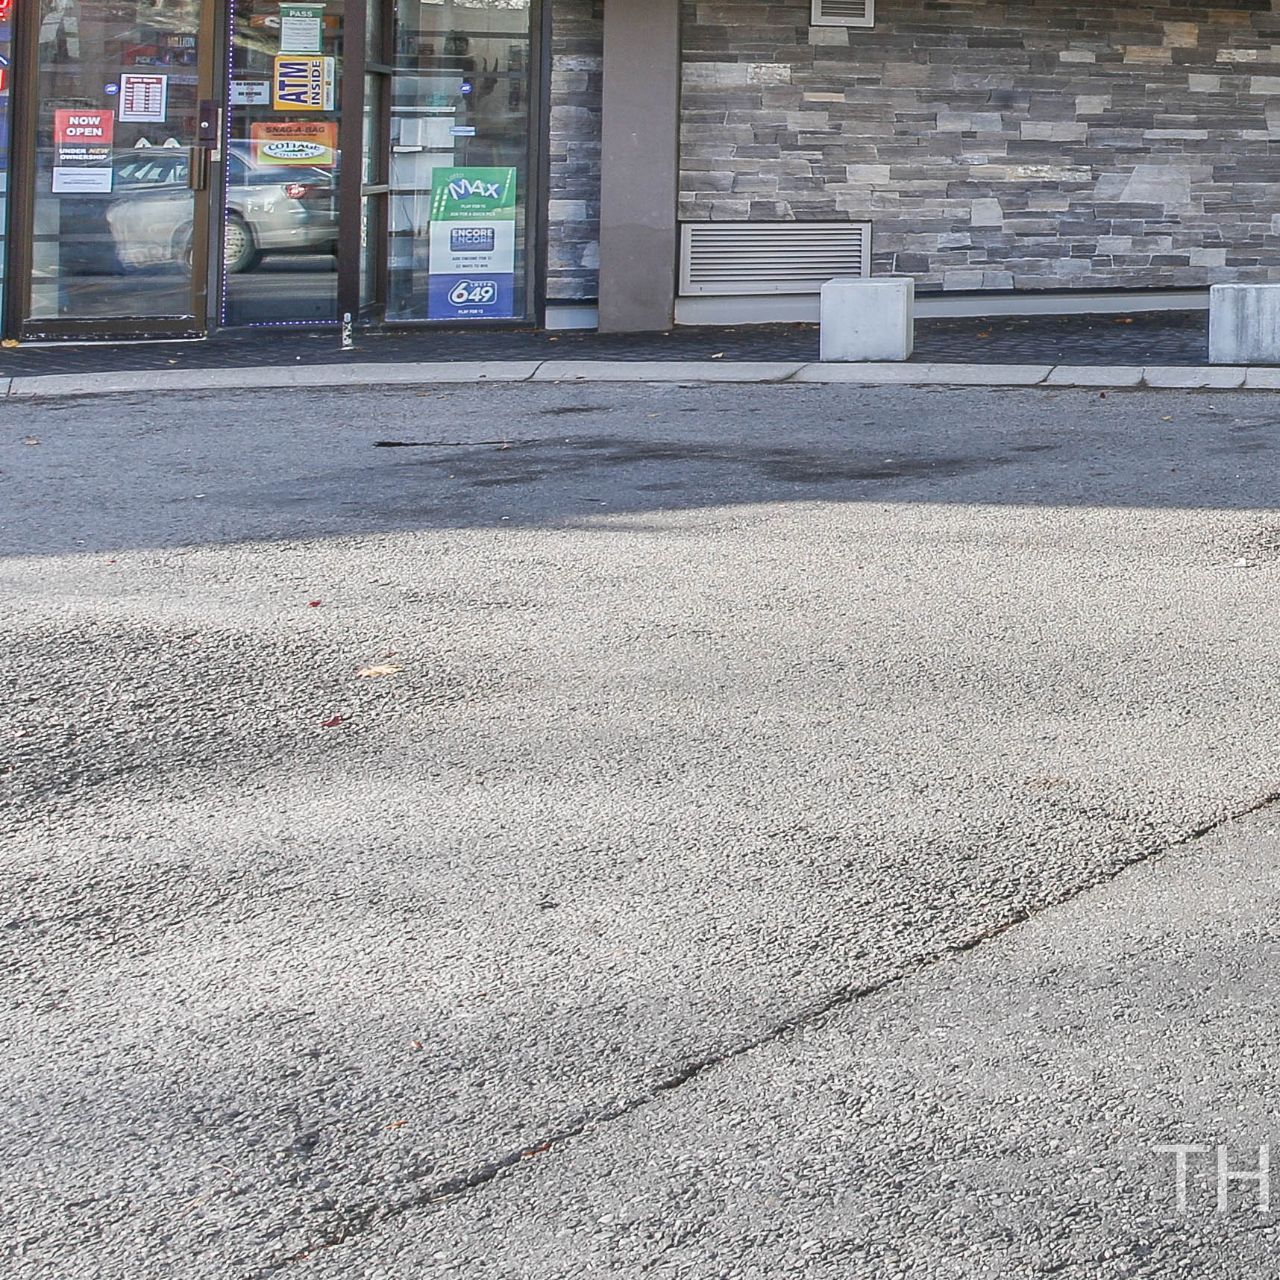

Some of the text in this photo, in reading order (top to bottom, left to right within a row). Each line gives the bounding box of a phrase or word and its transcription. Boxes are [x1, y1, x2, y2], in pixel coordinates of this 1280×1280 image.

[278, 62, 309, 104] ATM
[311, 61, 321, 105] INSIDE
[69, 117, 101, 125] NOW
[66, 128, 103, 136] OPEN
[449, 179, 500, 200] MAX
